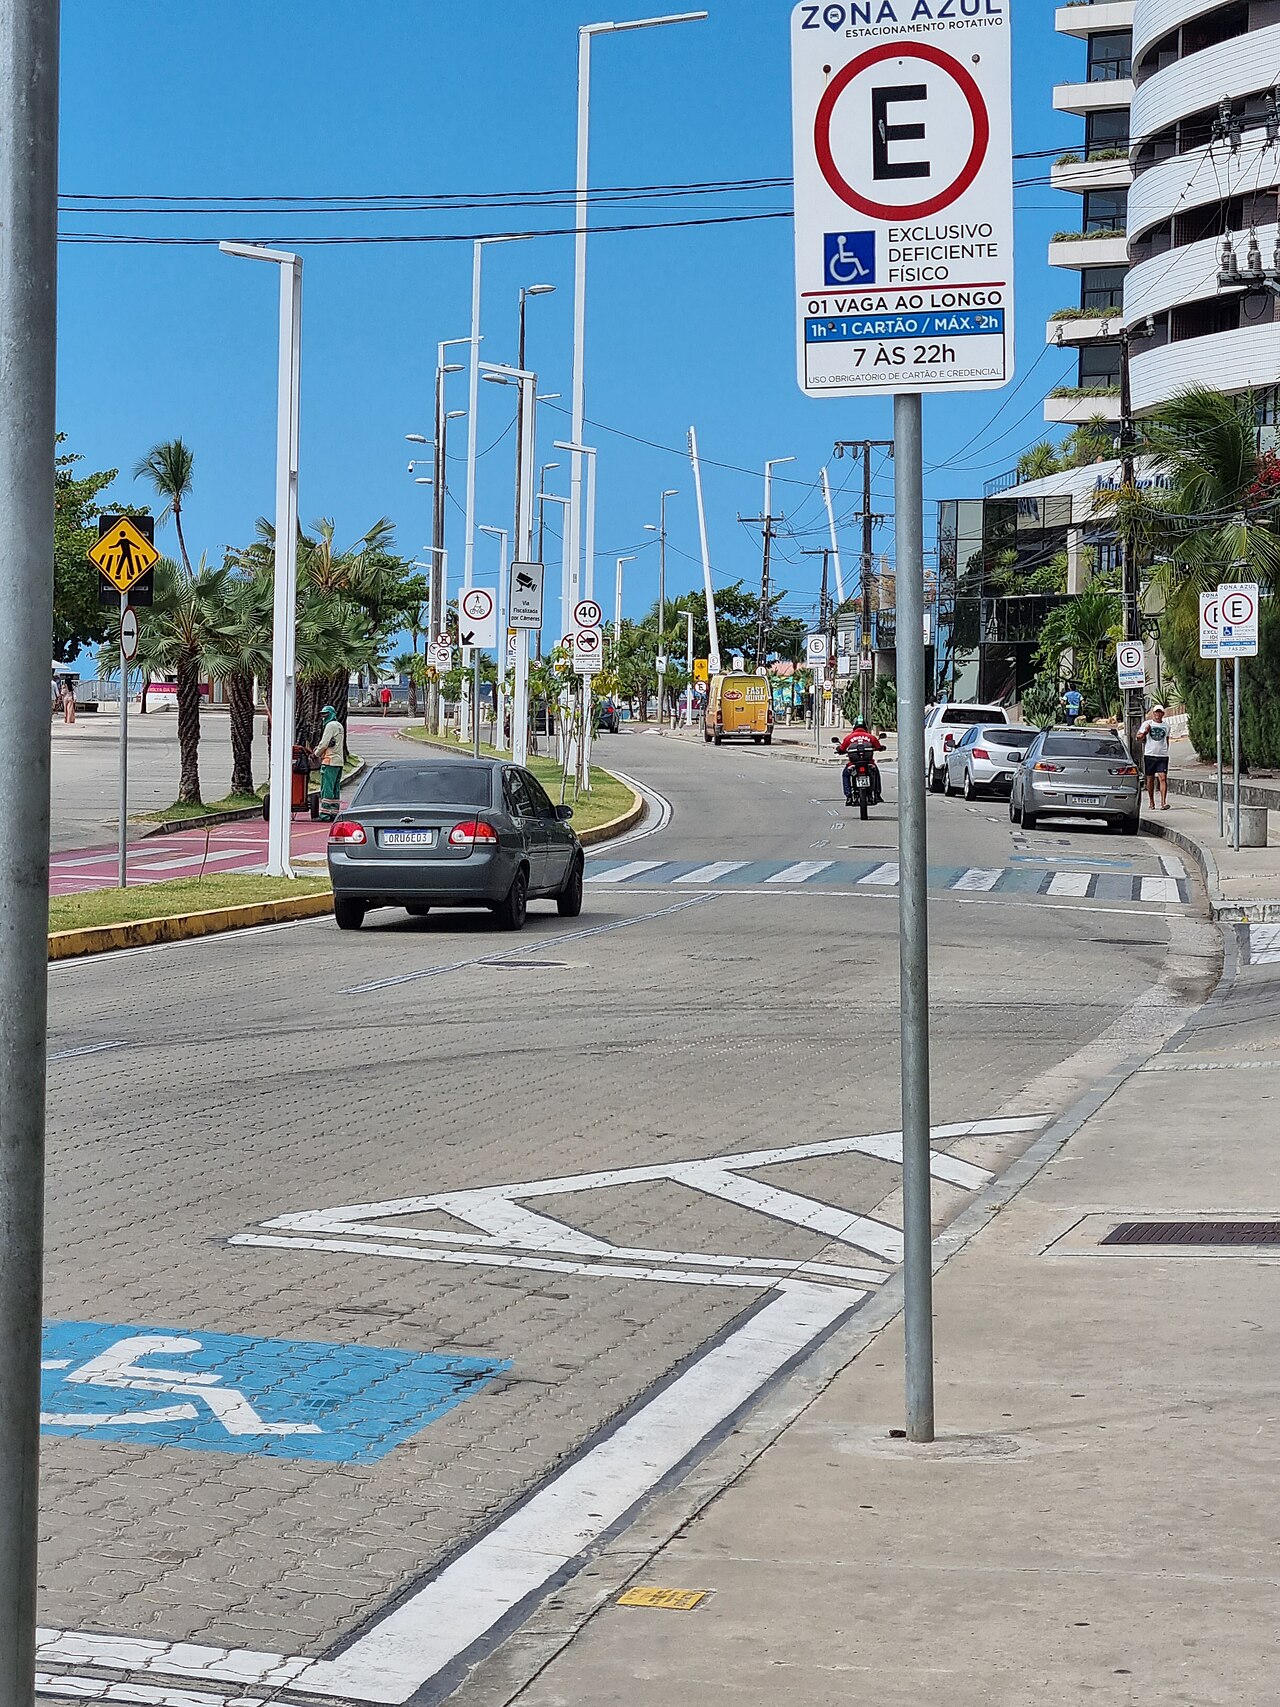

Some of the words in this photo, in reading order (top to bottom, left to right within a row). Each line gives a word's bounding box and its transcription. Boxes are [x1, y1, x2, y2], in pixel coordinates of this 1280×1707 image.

[801, 0, 898, 32] ZONA
[911, 0, 1002, 21] AZUL
[845, 22, 945, 38] ESTACIONAMENTO
[949, 17, 1003, 30] ROTATIVO
[871, 83, 931, 181] E
[888, 223, 993, 242] EXCLUSIVO
[888, 243, 998, 263] DEFICIENTE
[888, 264, 949, 283] FÍSICO
[807, 299, 827, 314] 01
[834, 296, 888, 313] VAGA
[894, 295, 923, 311] AO
[931, 290, 1002, 308] LONGO
[811, 323, 827, 337] 1h
[840, 323, 847, 335] 1
[851, 317, 918, 335] CARTÃO
[921, 317, 931, 333] /
[934, 313, 975, 331] MÁX.
[980, 314, 999, 329] 2h
[853, 348, 867, 367] 7
[873, 342, 906, 366] ÀS
[913, 343, 956, 364] 22h
[808, 374, 827, 384] USO
[828, 370, 887, 383] OBRIGATÓRIO
[888, 372, 900, 380] DE
[901, 369, 938, 379] CARTÃO
[939, 370, 945, 378] E
[946, 367, 1002, 377] CREDENCIAL
[578, 606, 597, 618] 40
[1232, 601, 1243, 618] E
[1126, 652, 1135, 663] E
[746, 686, 765, 695] FAST
